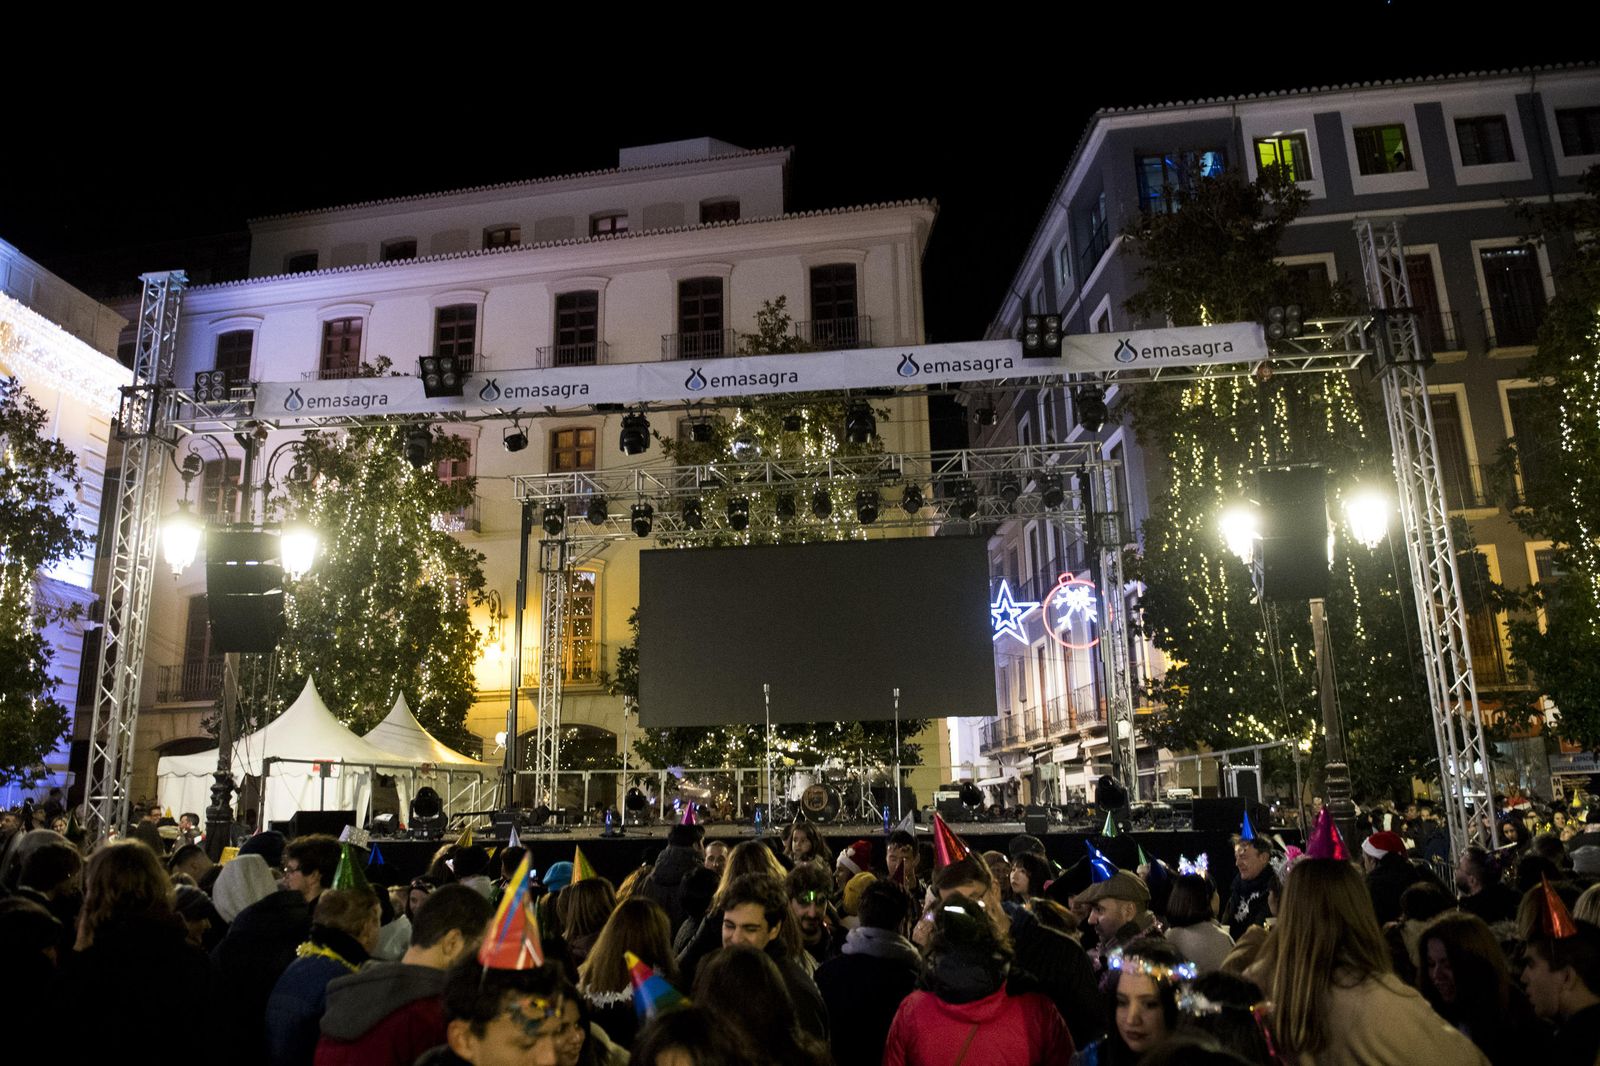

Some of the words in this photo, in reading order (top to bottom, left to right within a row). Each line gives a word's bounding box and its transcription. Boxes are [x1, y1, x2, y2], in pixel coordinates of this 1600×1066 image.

[1141, 341, 1234, 360] emasagra
[923, 357, 1014, 374] emasagra
[710, 371, 799, 388] emasagra
[503, 383, 589, 400] emasagra
[306, 394, 388, 410] emasagra
